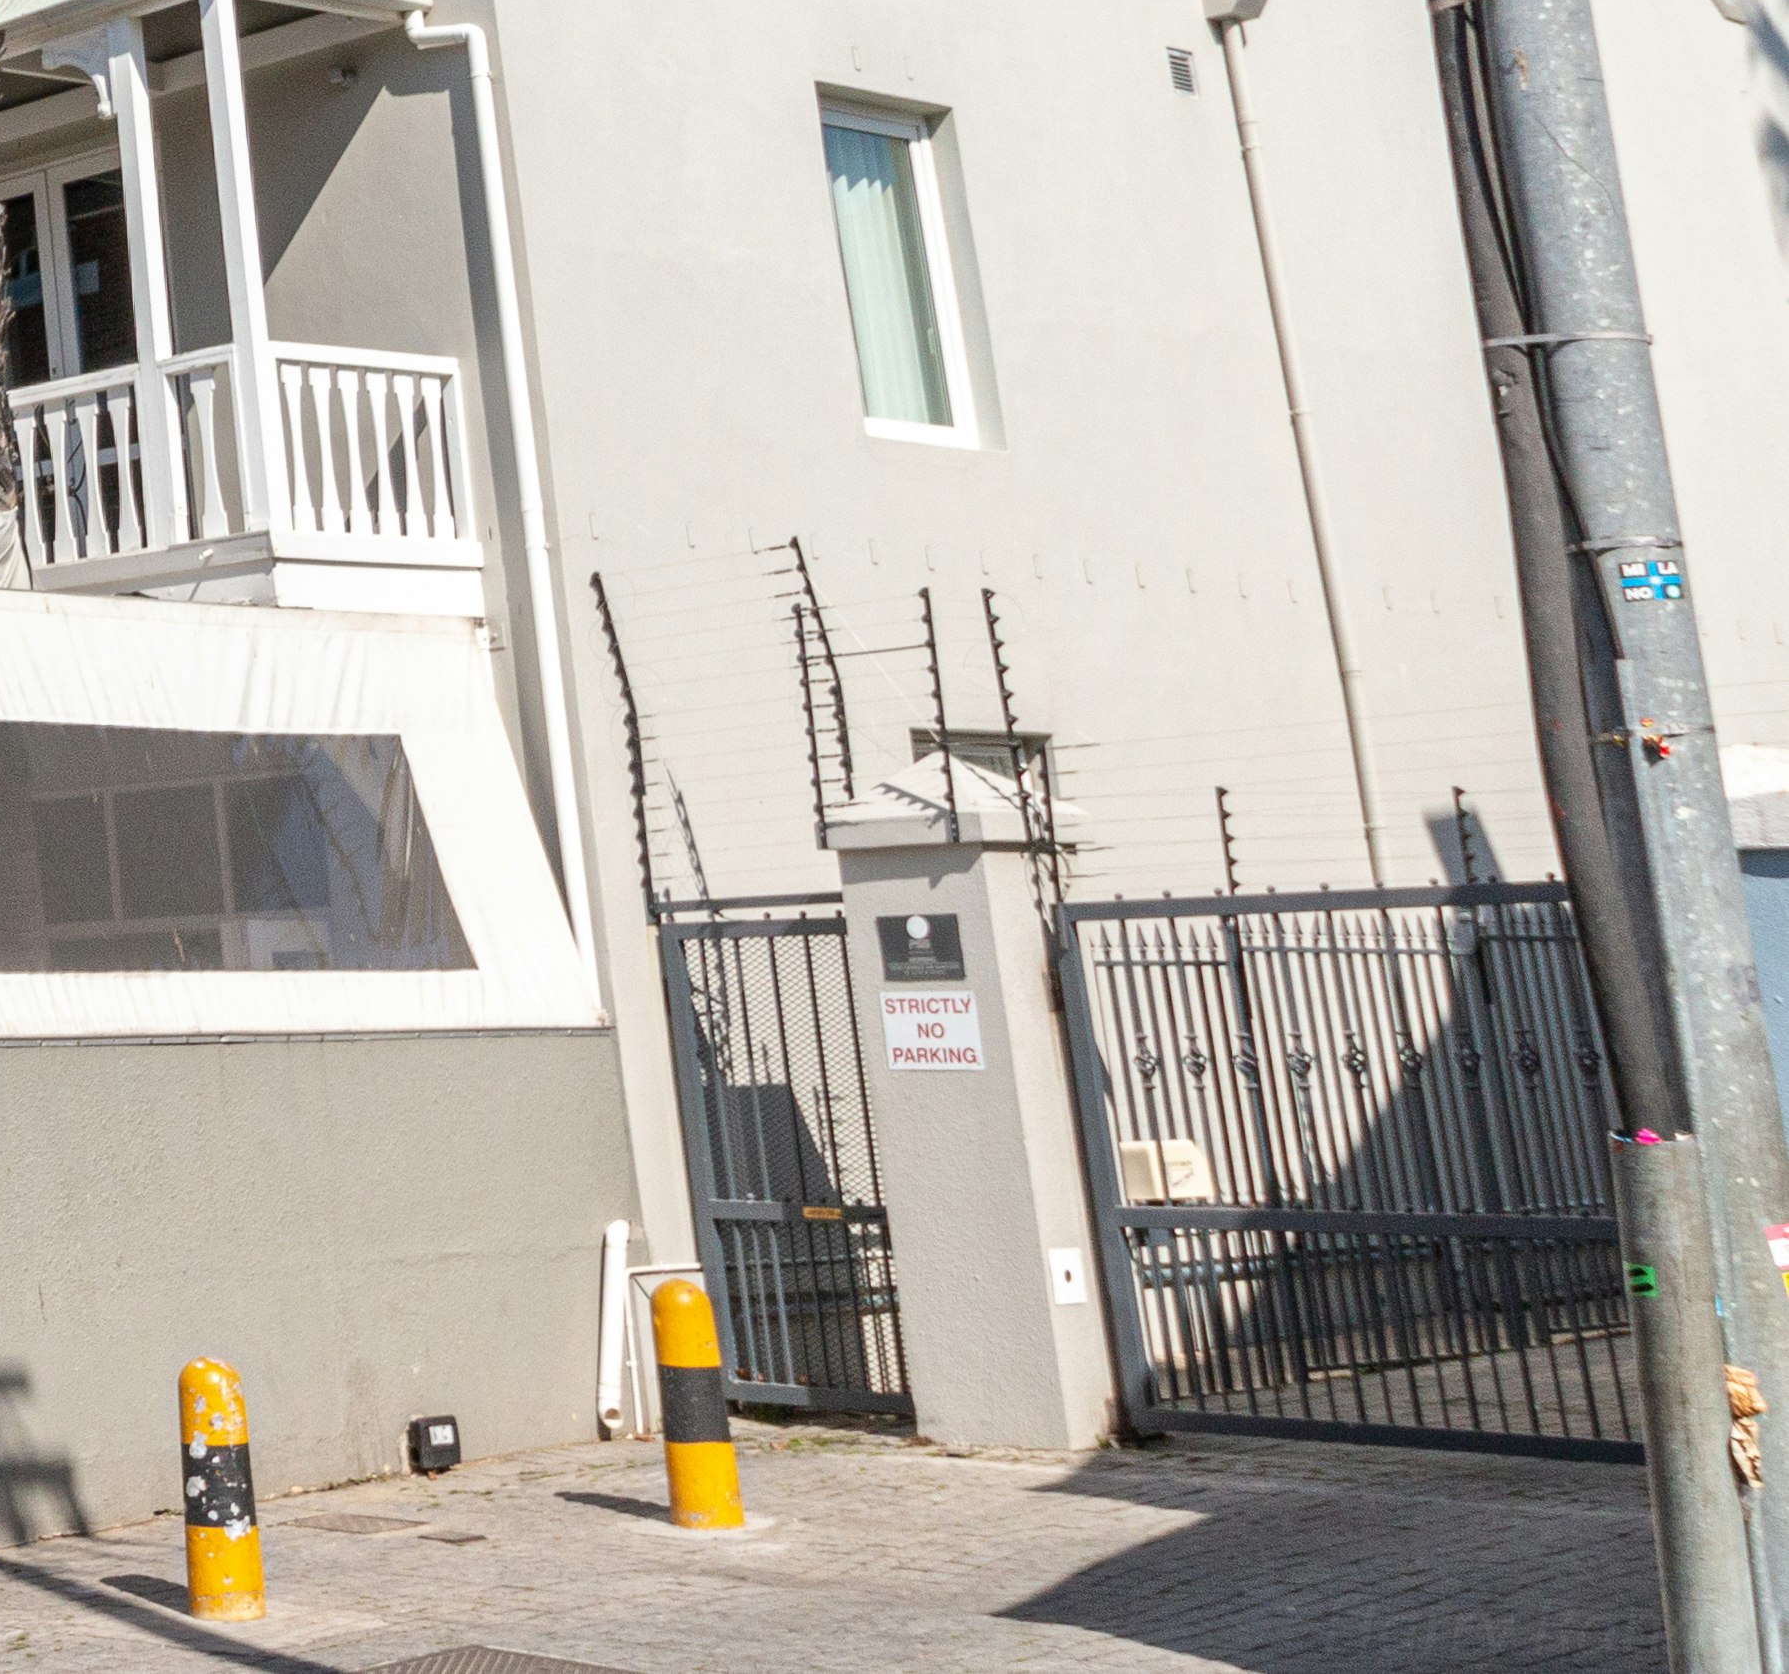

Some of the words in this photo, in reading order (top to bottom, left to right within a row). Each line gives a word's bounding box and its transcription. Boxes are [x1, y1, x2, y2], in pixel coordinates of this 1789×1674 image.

[1621, 563, 1646, 577] MI
[1657, 561, 1679, 575] LA
[1624, 586, 1654, 601] NO
[884, 997, 972, 1015] STRICTLY
[917, 1023, 945, 1039] NO
[892, 1047, 978, 1065] PARKING
